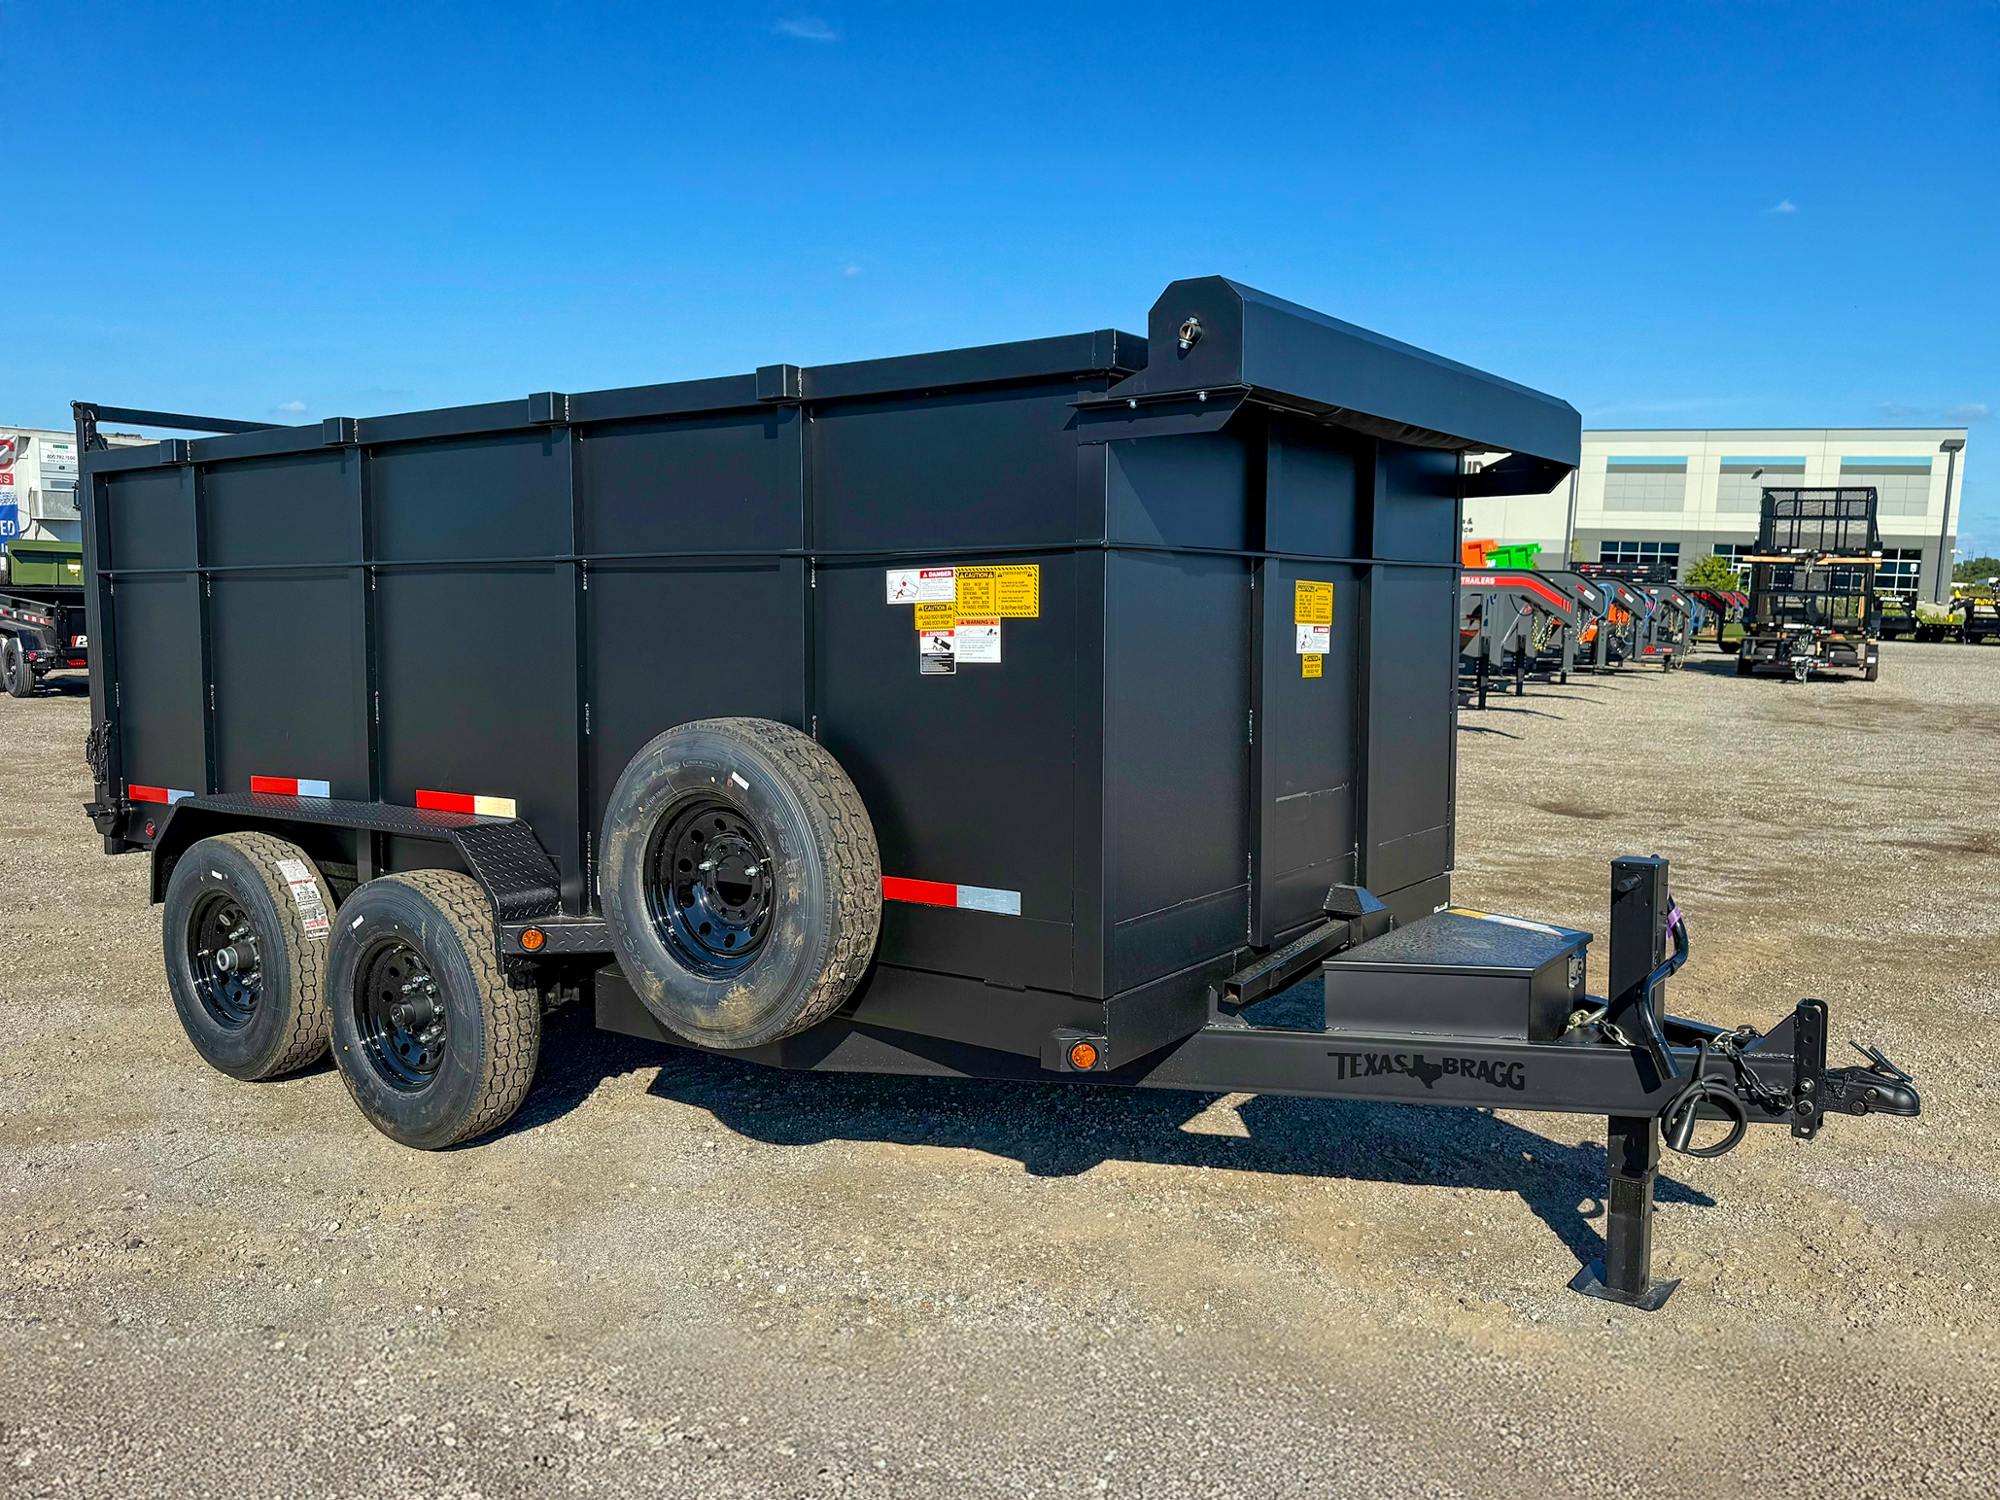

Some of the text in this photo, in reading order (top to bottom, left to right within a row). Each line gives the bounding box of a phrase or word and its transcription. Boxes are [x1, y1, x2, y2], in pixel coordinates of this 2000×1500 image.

[928, 570, 952, 578] DANGER
[1461, 576, 1495, 585] TRAILERS
[1327, 1052, 1526, 1091] TEXAS BRAGG
